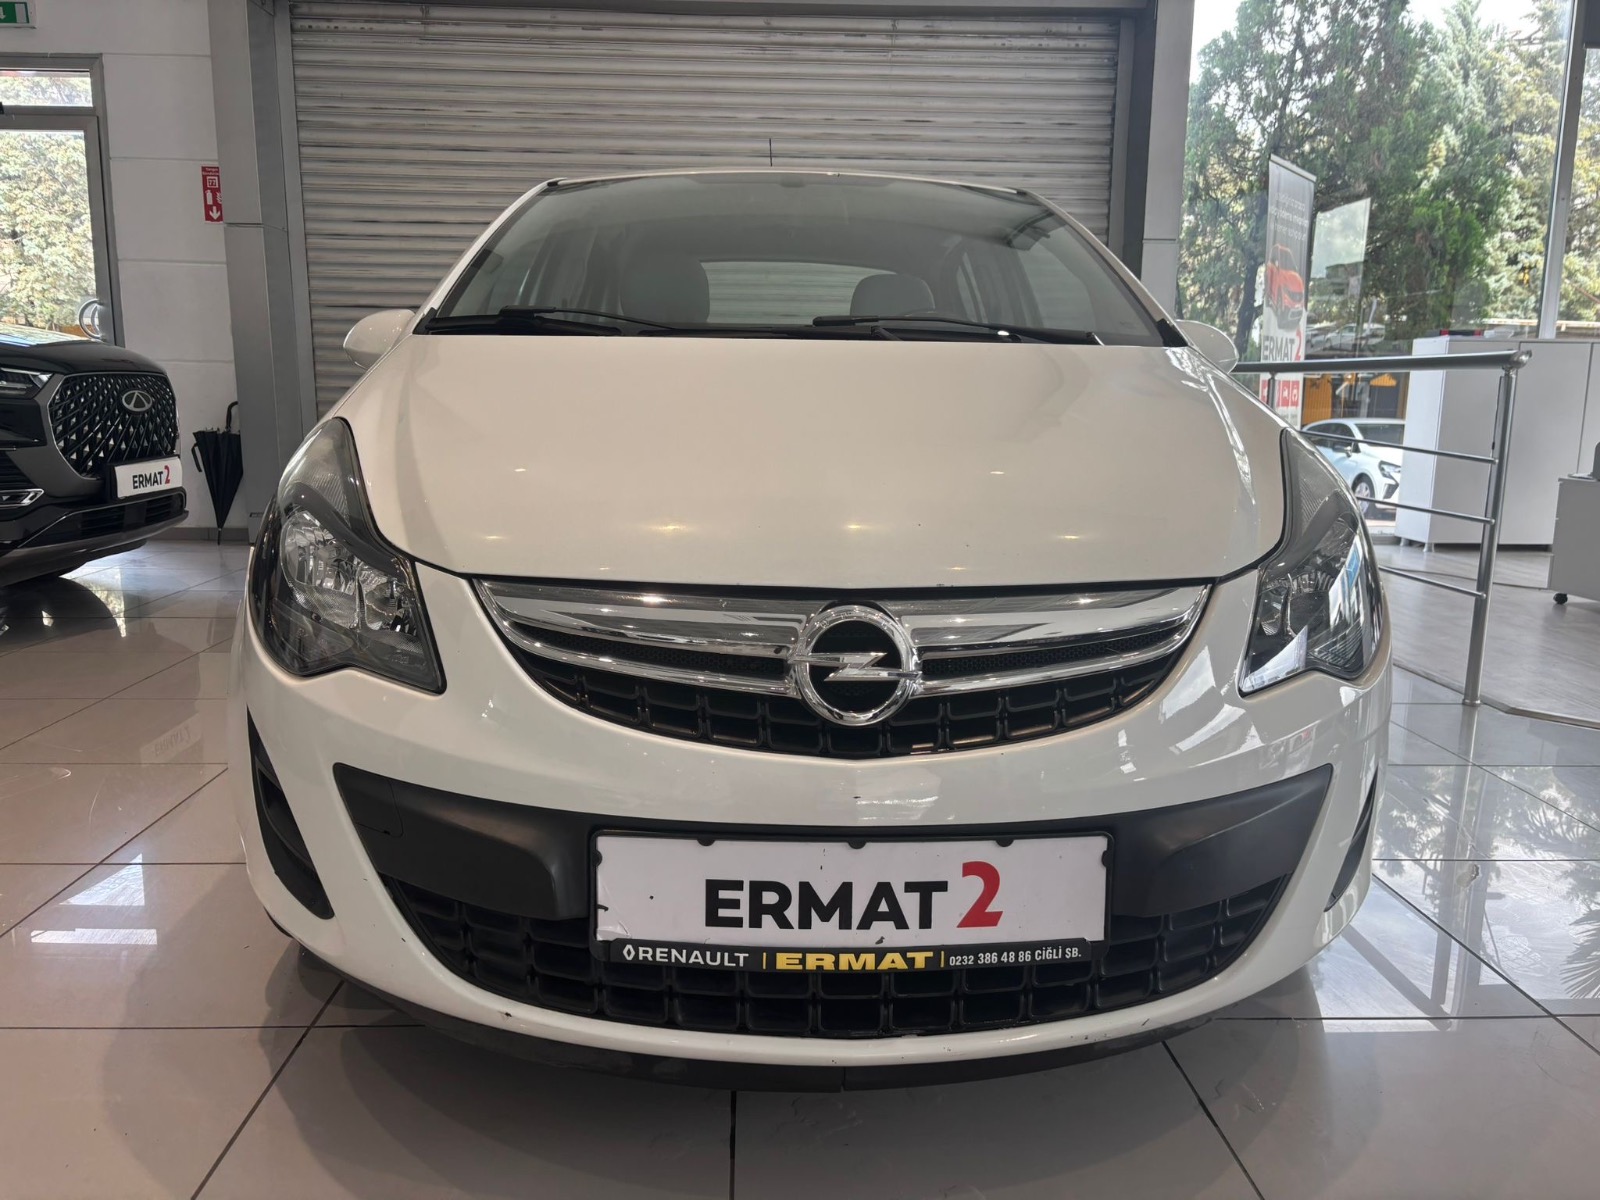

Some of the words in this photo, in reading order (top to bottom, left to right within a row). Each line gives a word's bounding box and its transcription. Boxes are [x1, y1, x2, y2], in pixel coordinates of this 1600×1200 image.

[1262, 335, 1295, 361] ERMAT
[1294, 328, 1302, 361] 2
[132, 471, 163, 489] ERMAT
[164, 465, 170, 484] 2
[705, 879, 948, 931] ERMAT
[956, 860, 1003, 928] 2
[637, 946, 749, 967] RENAULT
[776, 951, 933, 971] ERMAT
[949, 955, 974, 966] 0232
[977, 951, 998, 965] 386
[1000, 951, 1015, 963] 48
[1018, 950, 1031, 962] 86
